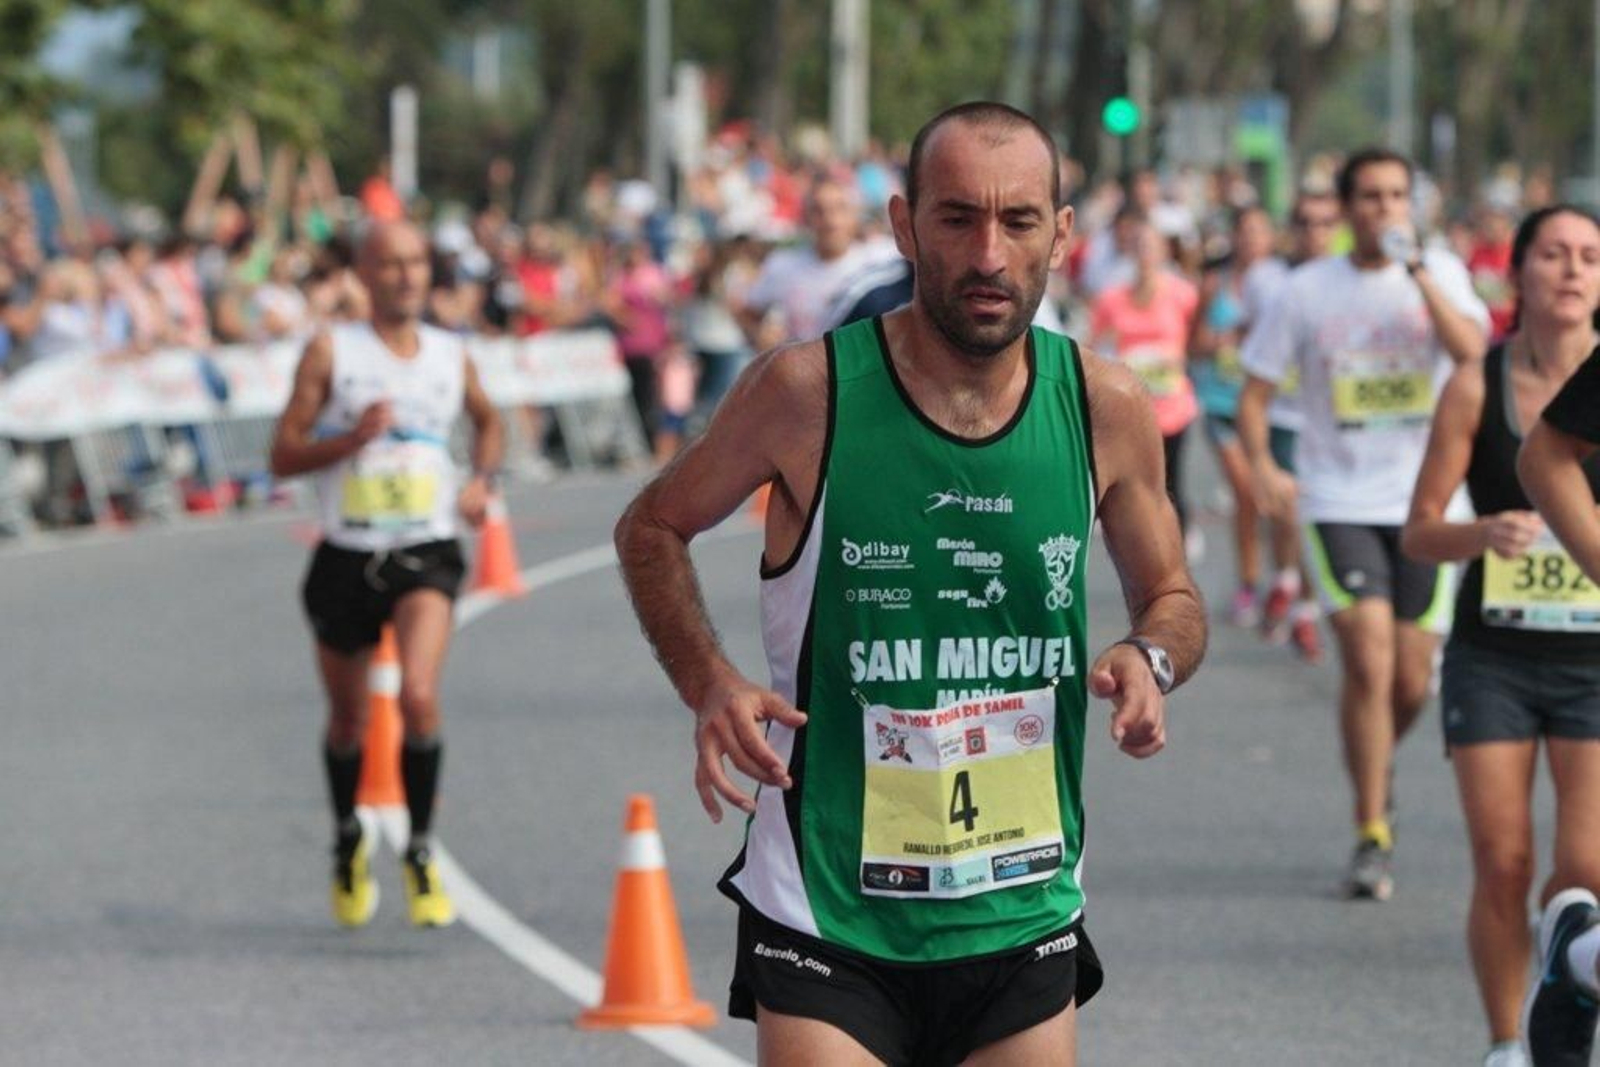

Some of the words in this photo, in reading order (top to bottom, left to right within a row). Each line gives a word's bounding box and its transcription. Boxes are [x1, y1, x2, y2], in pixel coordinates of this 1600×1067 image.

[863, 541, 911, 559] dibay
[858, 588, 912, 602] BURACO
[849, 638, 922, 683] SAN
[936, 635, 1076, 680] MIGUEL
[962, 703, 981, 718] DE
[983, 697, 1025, 715] SAMIL
[950, 770, 979, 833] 4
[903, 842, 941, 855] RAMALLO
[993, 827, 1025, 842] ANTONIO
